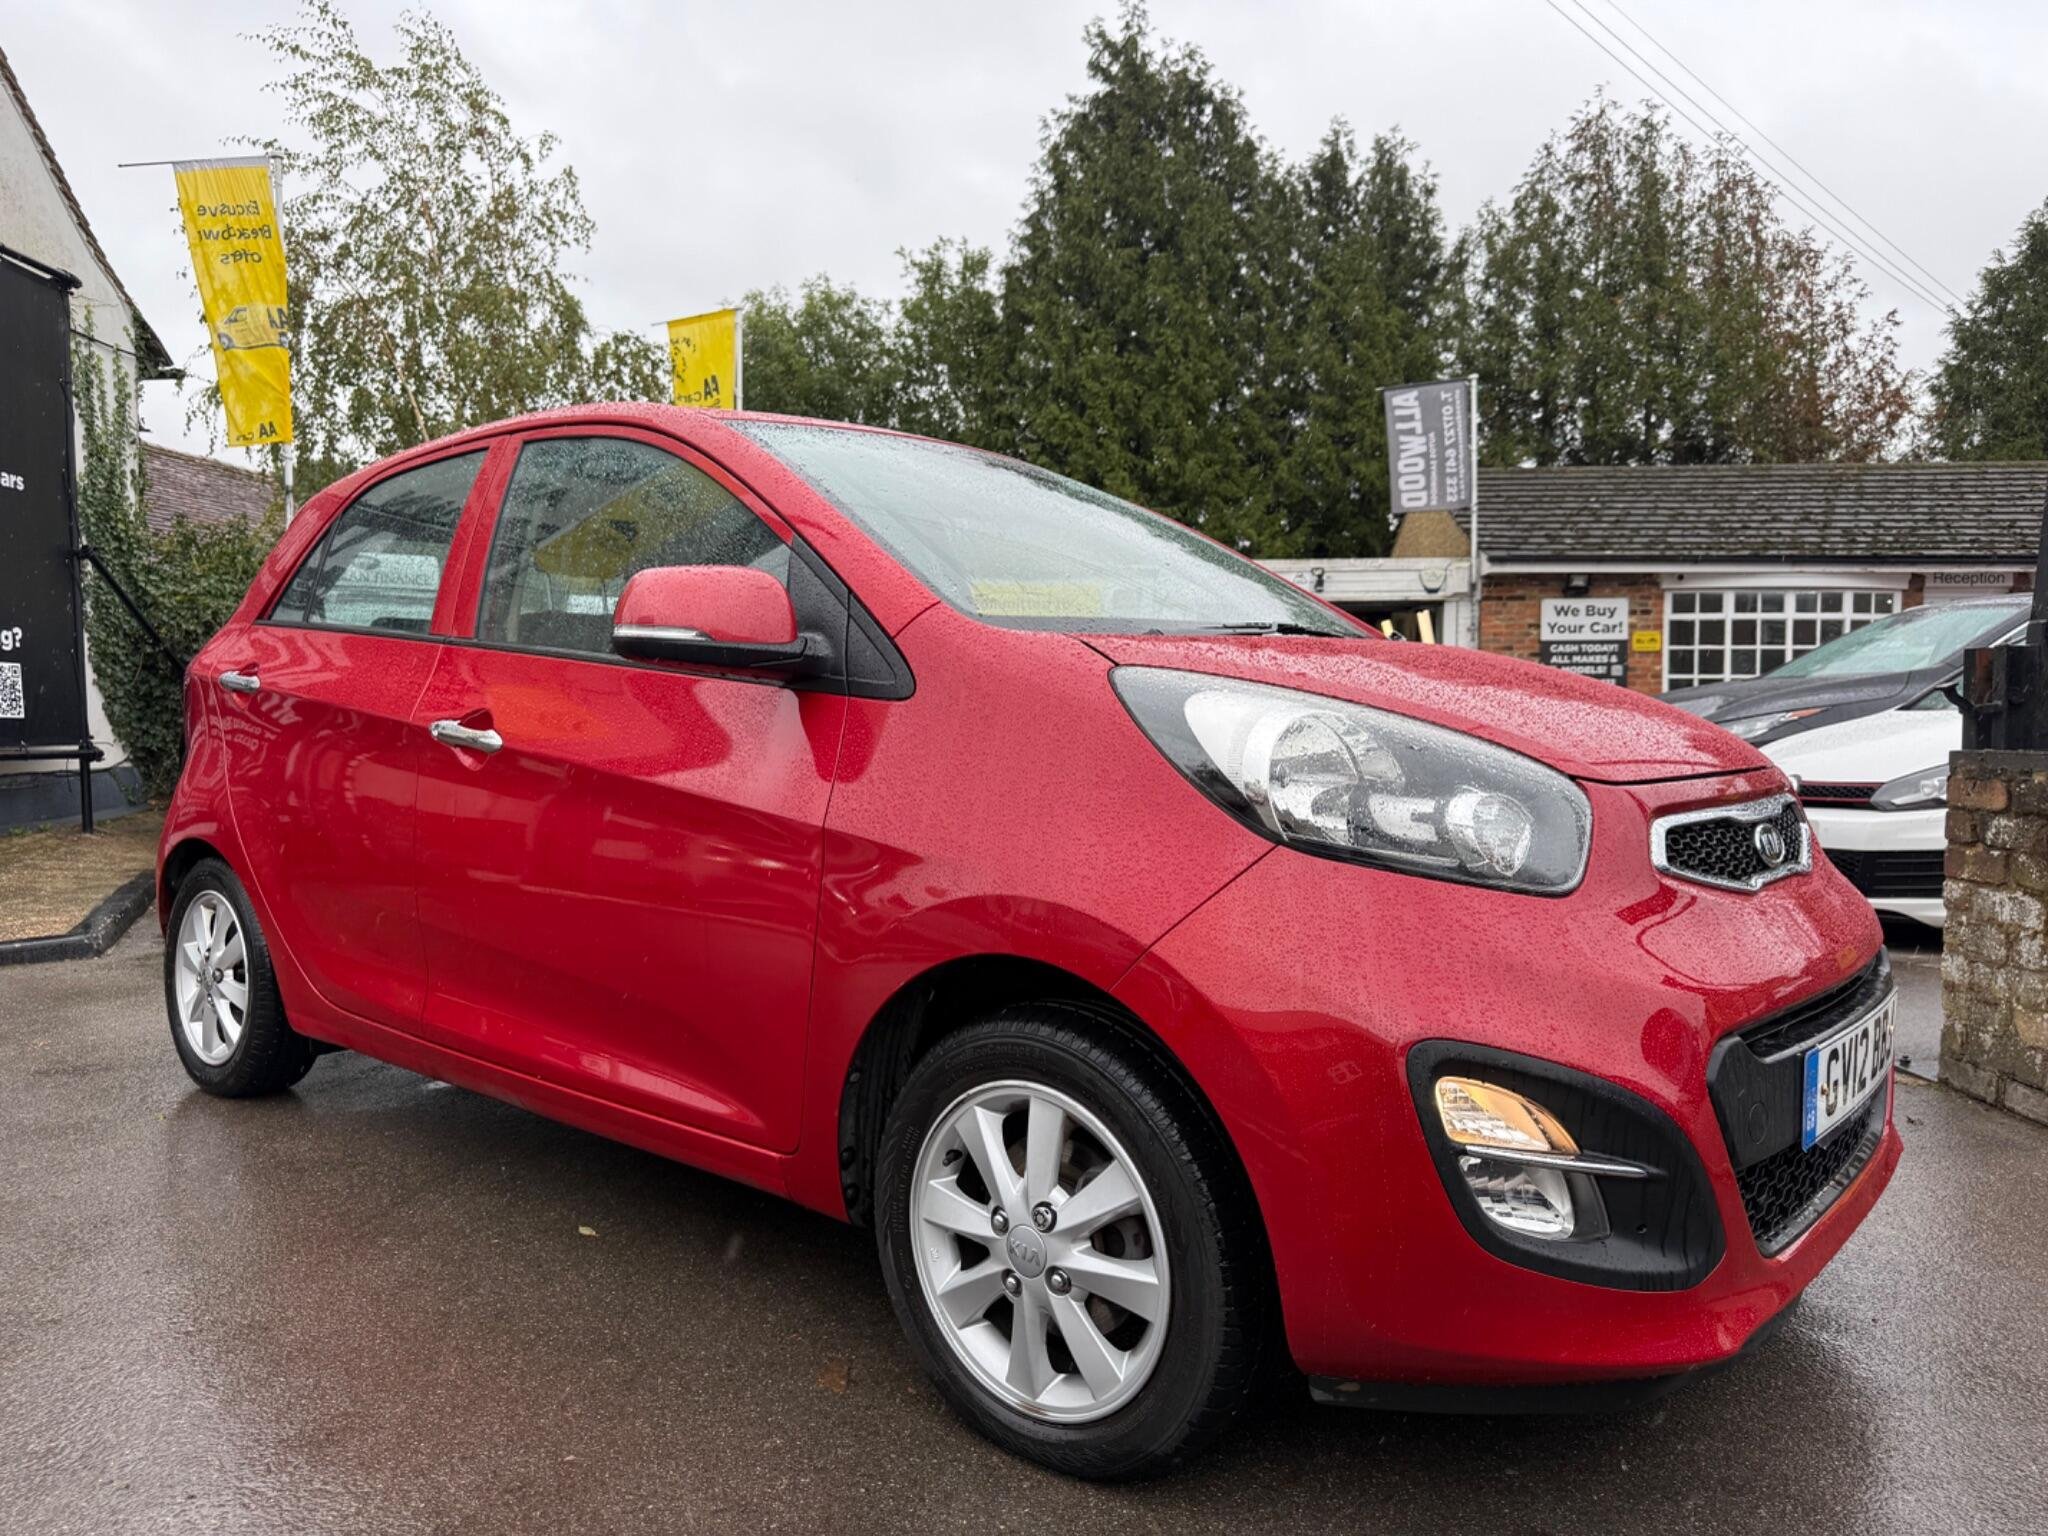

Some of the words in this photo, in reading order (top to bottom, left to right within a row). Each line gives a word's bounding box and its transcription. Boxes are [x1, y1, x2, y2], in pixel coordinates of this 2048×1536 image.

[1933, 572, 2006, 587] Reception
[1554, 605, 1580, 617] We
[1585, 605, 1617, 619] Buy
[1547, 622, 1585, 634] Your
[1590, 622, 1624, 634] Car!
[1550, 644, 1578, 653] CASH
[1580, 644, 1619, 653] TODAY!
[1550, 655, 1570, 663] ALL
[1572, 655, 1609, 663] MAKES
[1610, 655, 1618, 663] &
[1825, 1027, 1869, 1117] GV12
[1010, 1238, 1042, 1266] KIA
